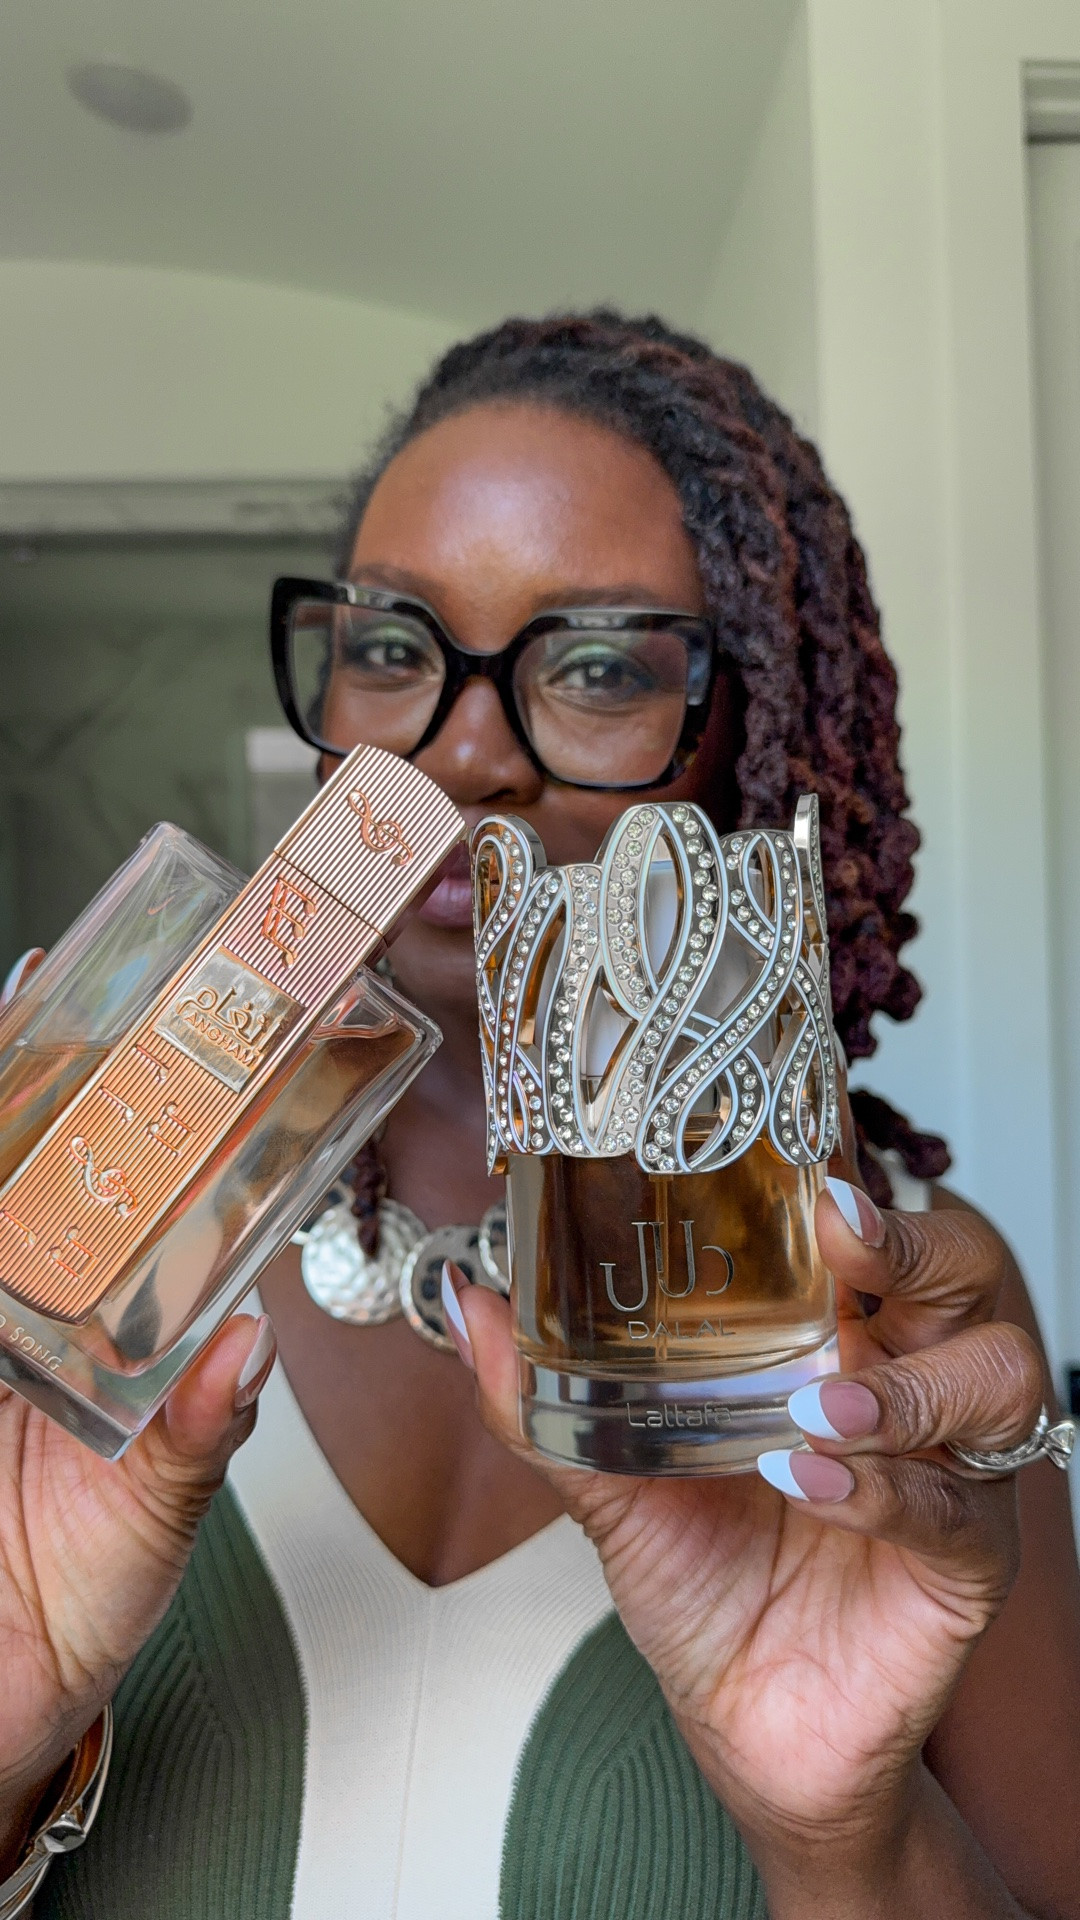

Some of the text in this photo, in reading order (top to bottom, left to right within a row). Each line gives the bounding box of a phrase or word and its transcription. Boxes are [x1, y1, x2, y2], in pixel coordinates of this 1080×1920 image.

[184, 1012, 265, 1068] ANGHAM
[599, 1220, 735, 1312] دلال
[9, 1326, 63, 1371] SONG
[627, 1317, 736, 1341] DALAL
[626, 1402, 732, 1429] Lattafa
